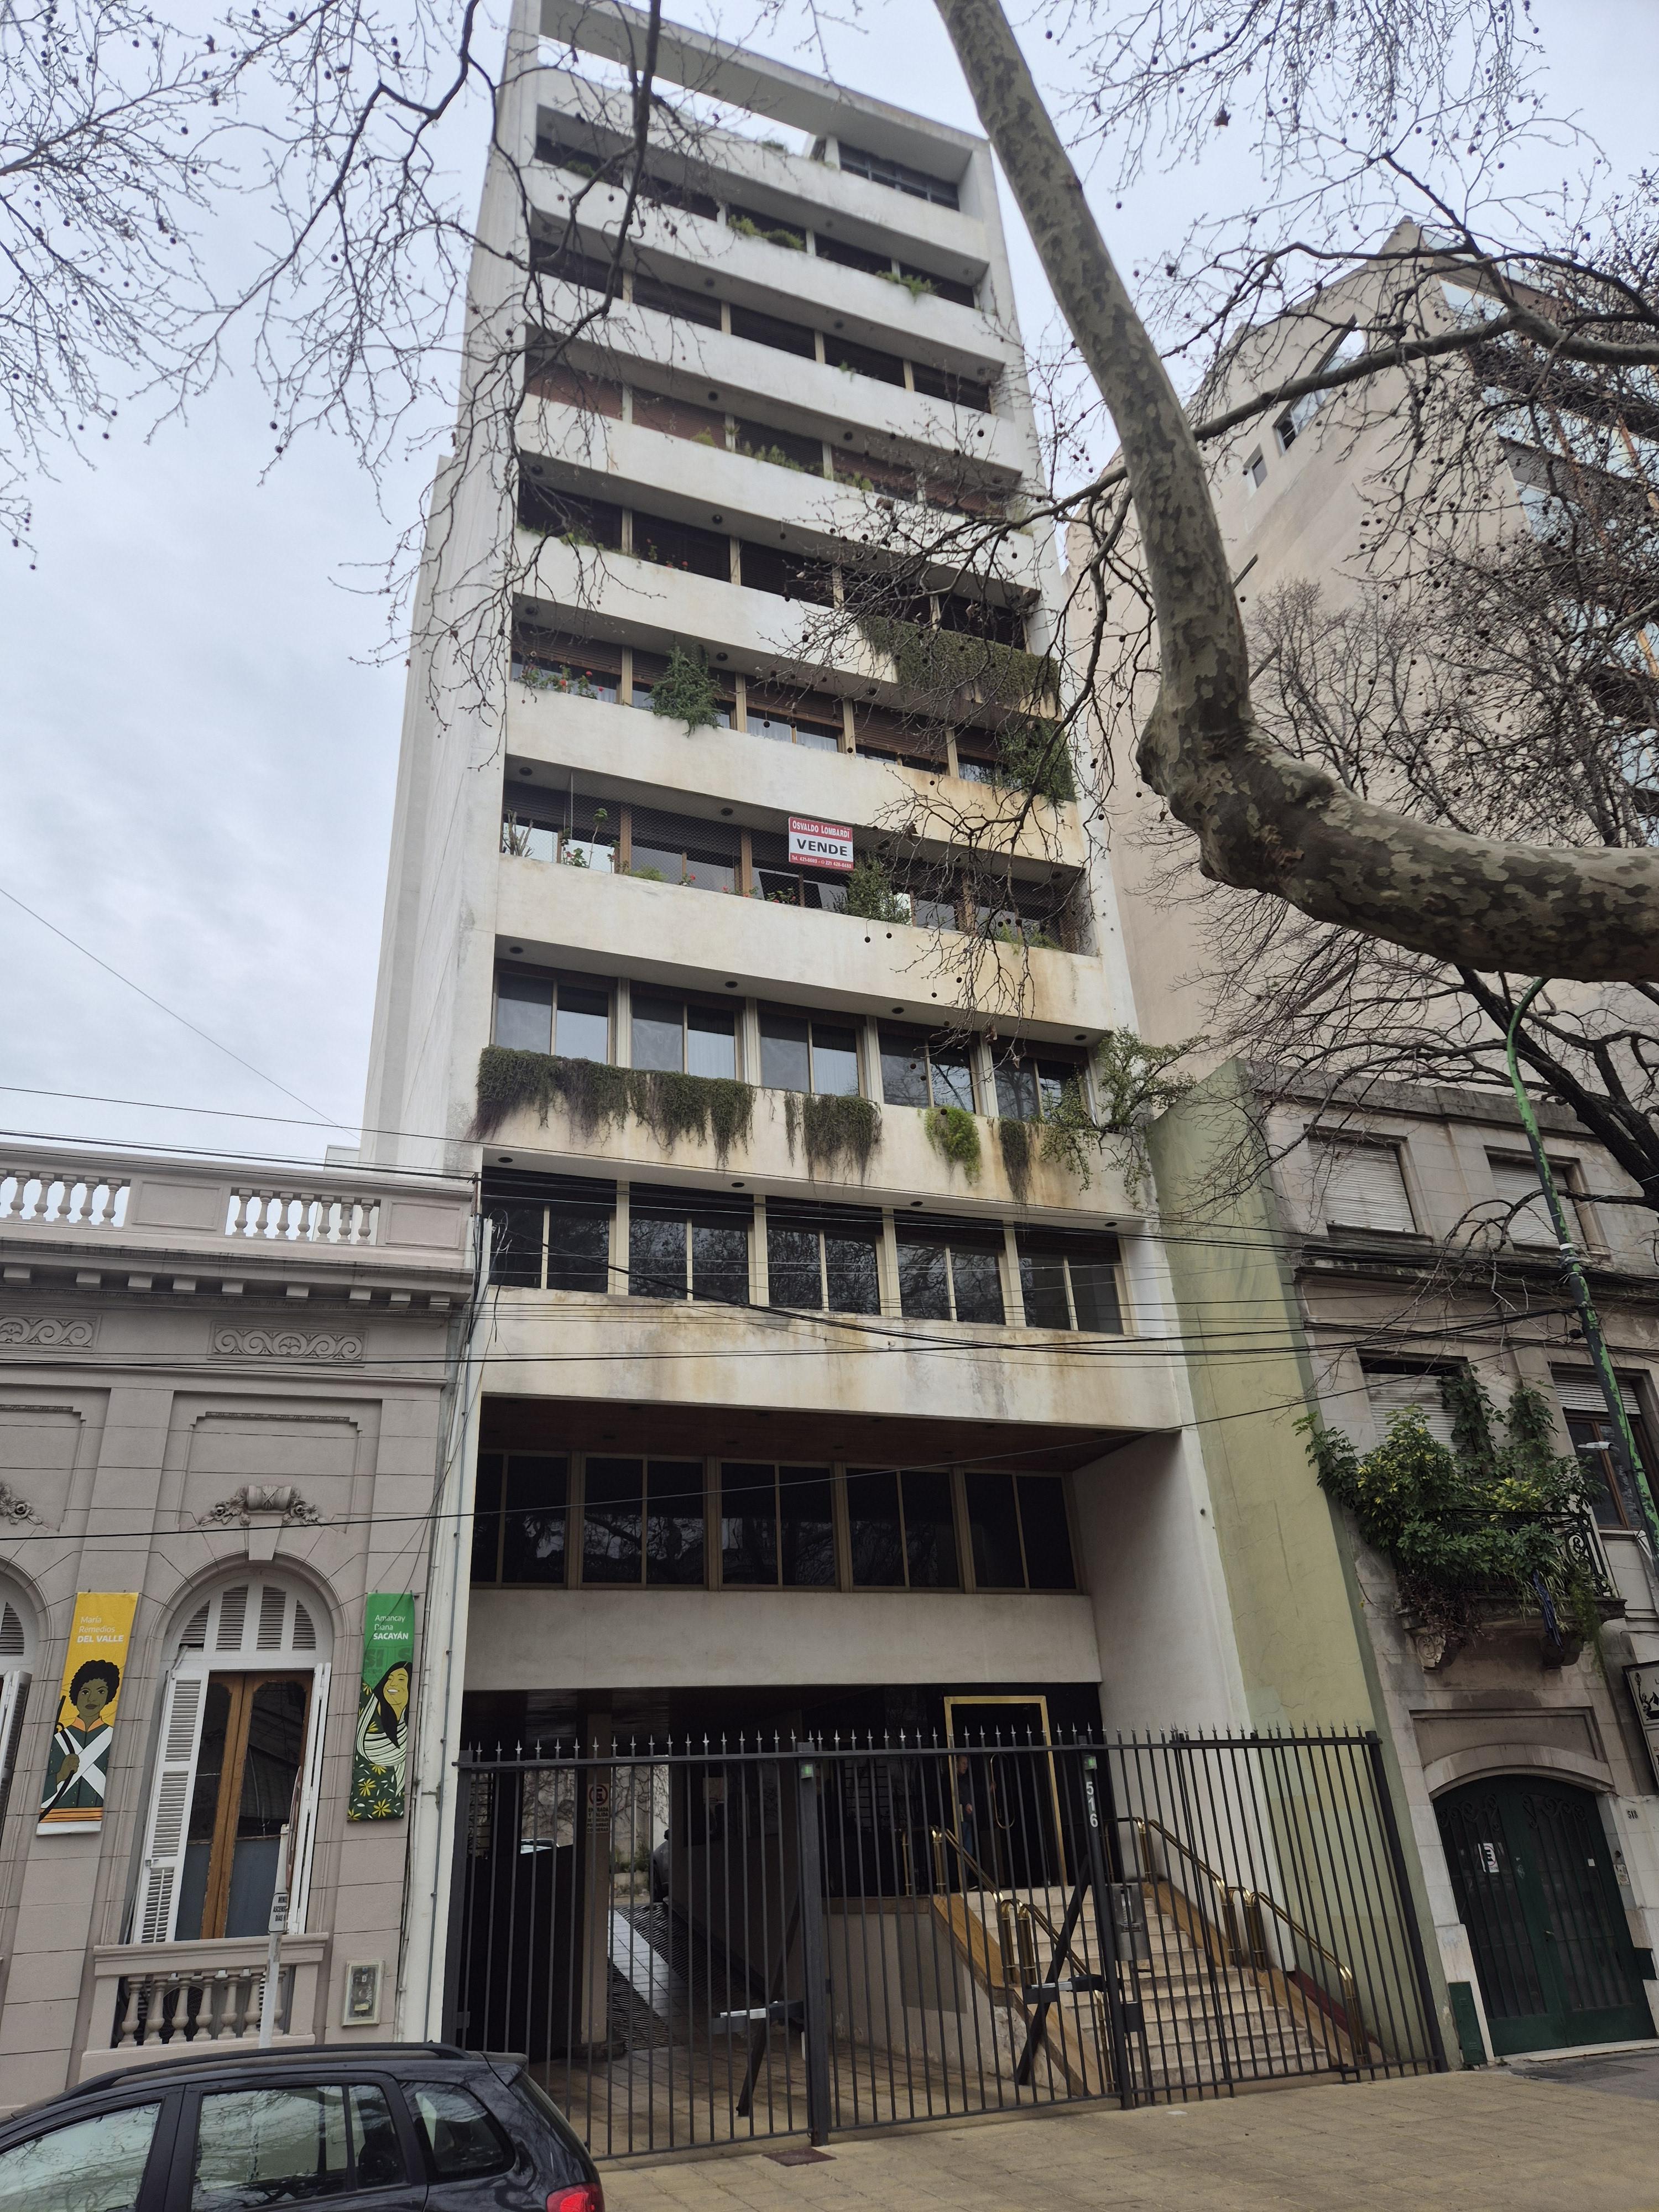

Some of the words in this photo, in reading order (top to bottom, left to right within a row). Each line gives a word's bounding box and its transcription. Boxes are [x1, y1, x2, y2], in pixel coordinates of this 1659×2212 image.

[792, 820, 819, 833] OSVALDO
[821, 825, 849, 838] LOMBARDI
[797, 838, 847, 856] VENDE
[373, 1631, 409, 1640] SACAYÁN
[1086, 1781, 1098, 1828] 516
[1627, 1810, 1638, 1819] 518
